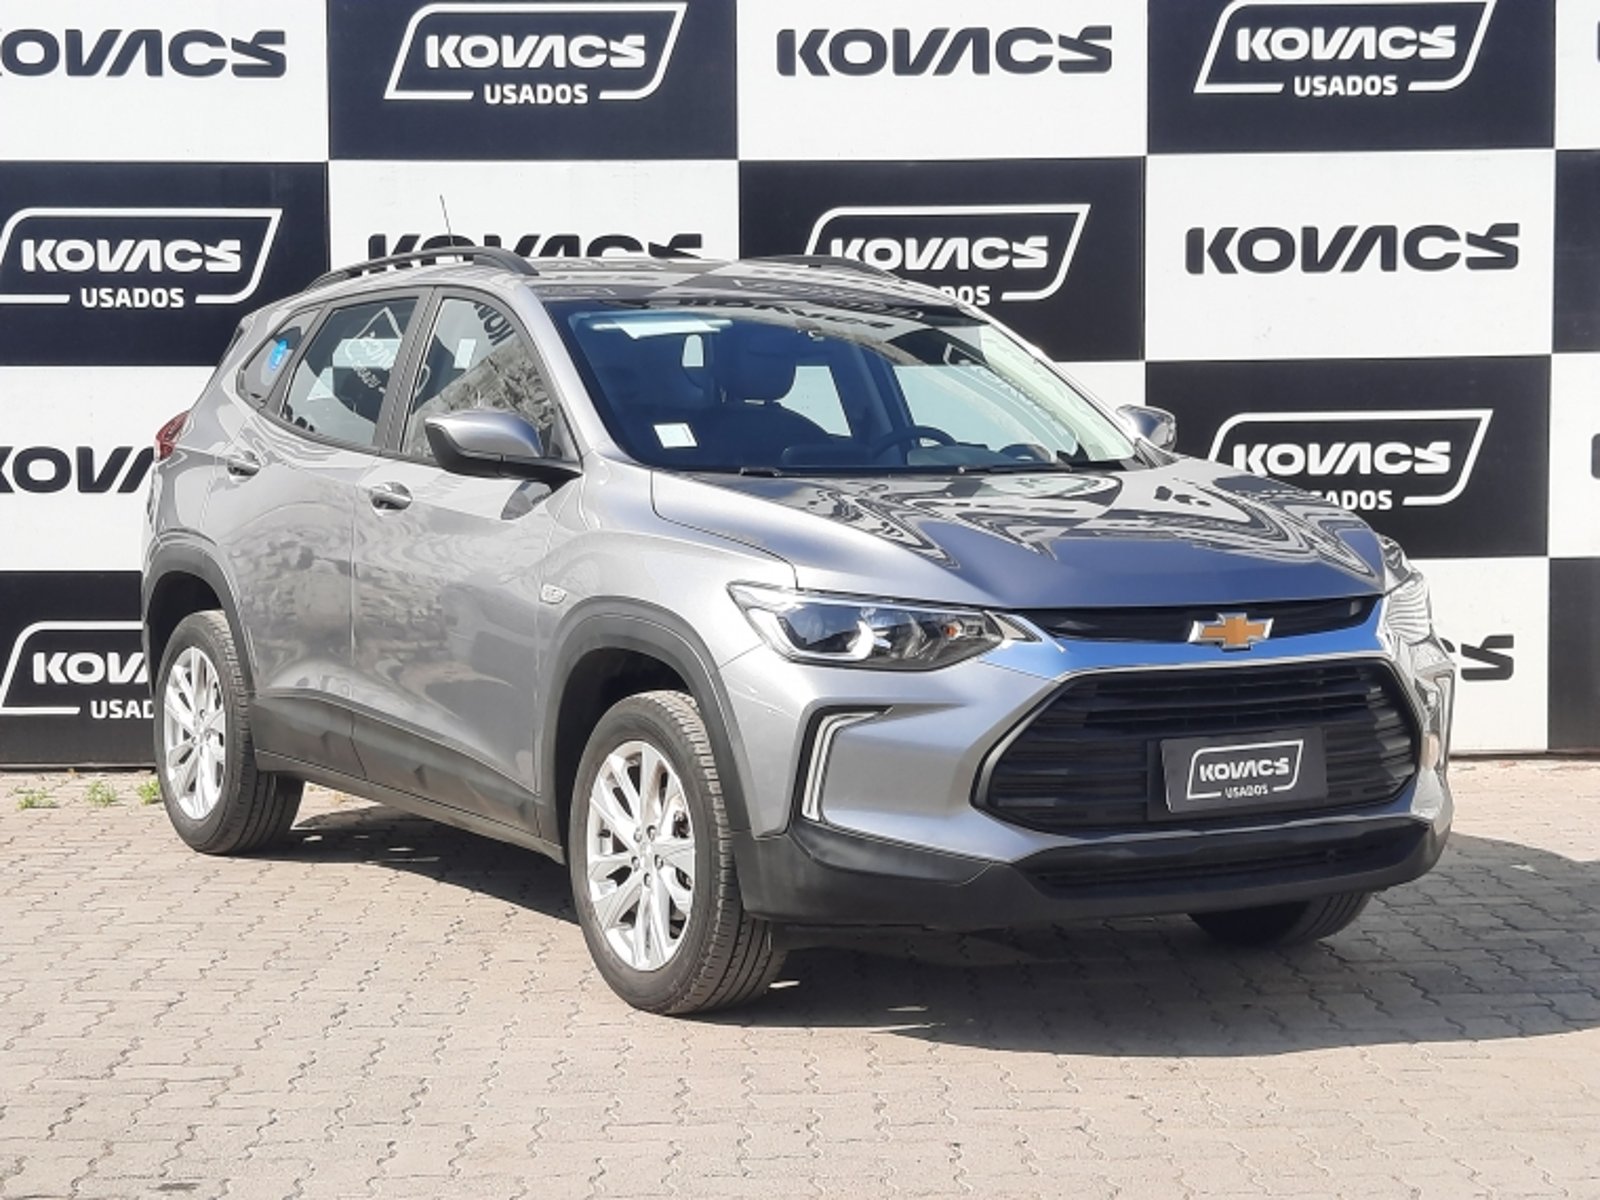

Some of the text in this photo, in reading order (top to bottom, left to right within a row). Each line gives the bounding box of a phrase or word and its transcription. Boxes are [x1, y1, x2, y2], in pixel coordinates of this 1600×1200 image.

[0, 29, 287, 78] OVACS
[425, 33, 646, 69] KOVACS
[777, 25, 1113, 76] KOVACS
[1236, 25, 1457, 60] KOVACS
[484, 84, 589, 105] USADOS
[1294, 75, 1398, 97] USADOS
[21, 239, 242, 273] KOVACS
[830, 236, 1049, 270] KOVACS
[1186, 223, 1520, 275] KOVACS
[80, 287, 185, 309] USADOS
[1233, 441, 1452, 476] KOVACS
[1309, 490, 1393, 511] ADOS
[90, 700, 155, 719] USAD
[1199, 757, 1290, 782] KOVACS
[1224, 784, 1269, 799] USADOS
